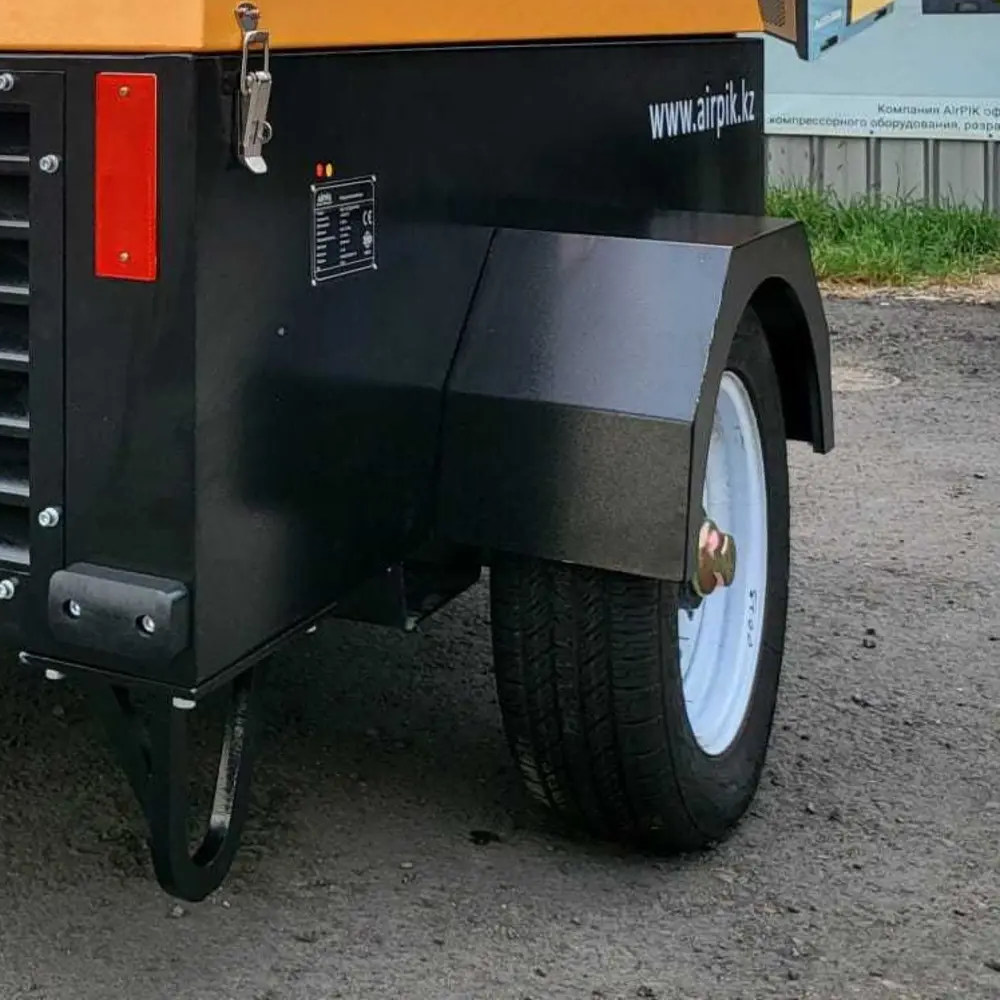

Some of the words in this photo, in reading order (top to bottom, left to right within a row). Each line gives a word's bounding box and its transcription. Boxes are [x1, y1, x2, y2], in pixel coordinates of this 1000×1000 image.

[649, 79, 755, 139] www.airpik.kz
[877, 103, 940, 115] Компания
[769, 116, 867, 128] компрессорного
